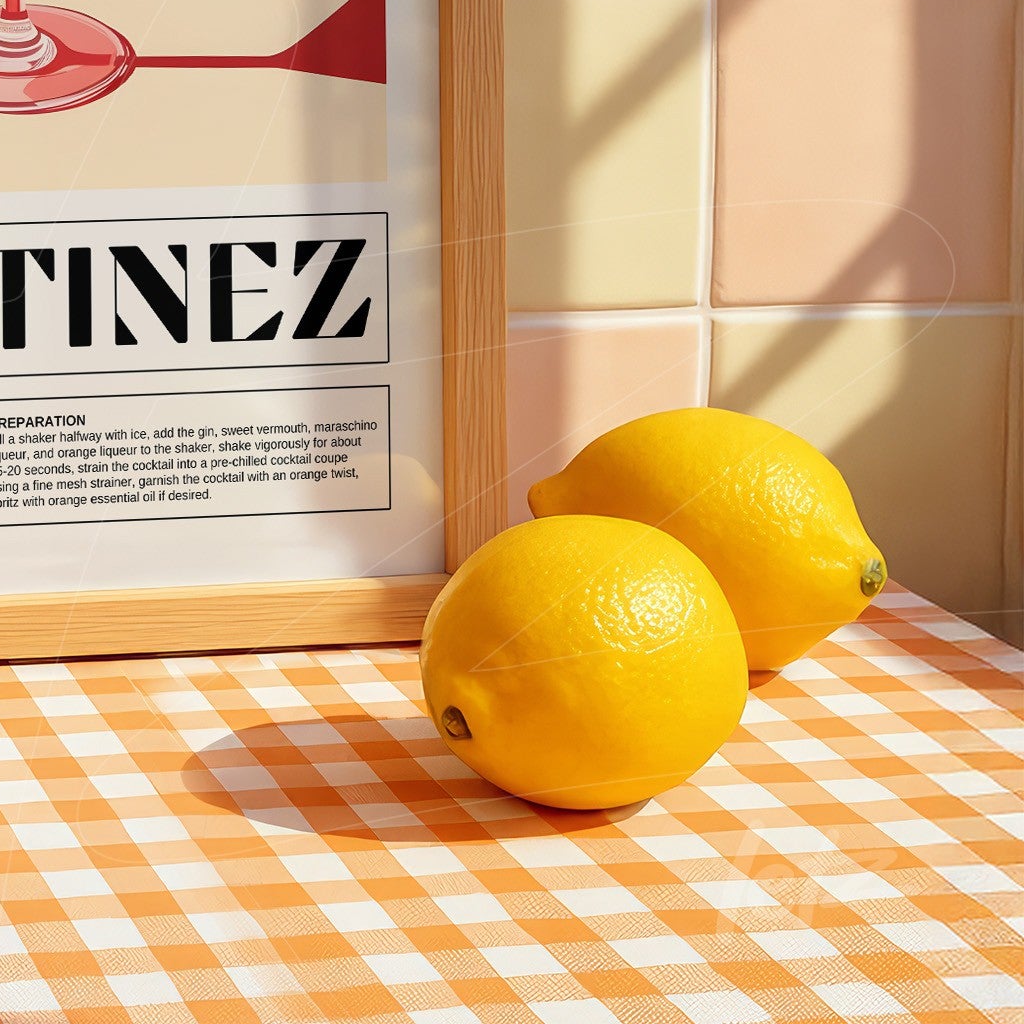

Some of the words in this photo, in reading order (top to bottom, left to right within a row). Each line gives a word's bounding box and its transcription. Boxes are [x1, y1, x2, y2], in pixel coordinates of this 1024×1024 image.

[8, 435, 16, 445] a
[18, 431, 57, 445] shaker
[59, 430, 103, 444] halfway
[104, 428, 128, 441] with
[130, 428, 150, 441] ice,
[153, 426, 174, 440] add
[177, 426, 195, 439] the
[197, 425, 218, 440] gin,
[221, 425, 254, 437] sweet
[256, 422, 311, 435] vermouth,
[314, 419, 378, 433] maraschino
[33, 447, 54, 460] and
[57, 447, 97, 460] orange
[99, 445, 138, 459] liqueur
[140, 444, 152, 456] to
[153, 443, 172, 455] the
[174, 441, 215, 454] shaker,
[218, 439, 252, 453] shake
[254, 437, 311, 453] vigorously
[312, 436, 328, 449] for
[330, 435, 362, 448] about
[24, 462, 75, 476] seconds,
[77, 461, 109, 474] strain
[111, 460, 130, 472] the
[132, 458, 174, 472] cocktail
[176, 458, 198, 470] into
[200, 459, 208, 469] a
[210, 454, 268, 471] pre-chilled
[270, 452, 312, 466] cocktail
[314, 453, 349, 466] coupe
[22, 482, 31, 492] a
[32, 479, 54, 491] fine
[56, 477, 88, 490] mesh
[89, 476, 136, 489] strainer,
[138, 473, 180, 490] garnish
[182, 473, 200, 485] the
[202, 471, 245, 484] cocktail
[246, 470, 270, 482] with
[272, 471, 287, 481] an
[289, 469, 328, 483] orange
[330, 466, 359, 480] twist,
[22, 495, 45, 507] with
[47, 496, 88, 508] orange
[90, 491, 140, 505] essential
[142, 490, 156, 502] oil
[158, 489, 166, 502] if
[167, 488, 212, 501] desired.
